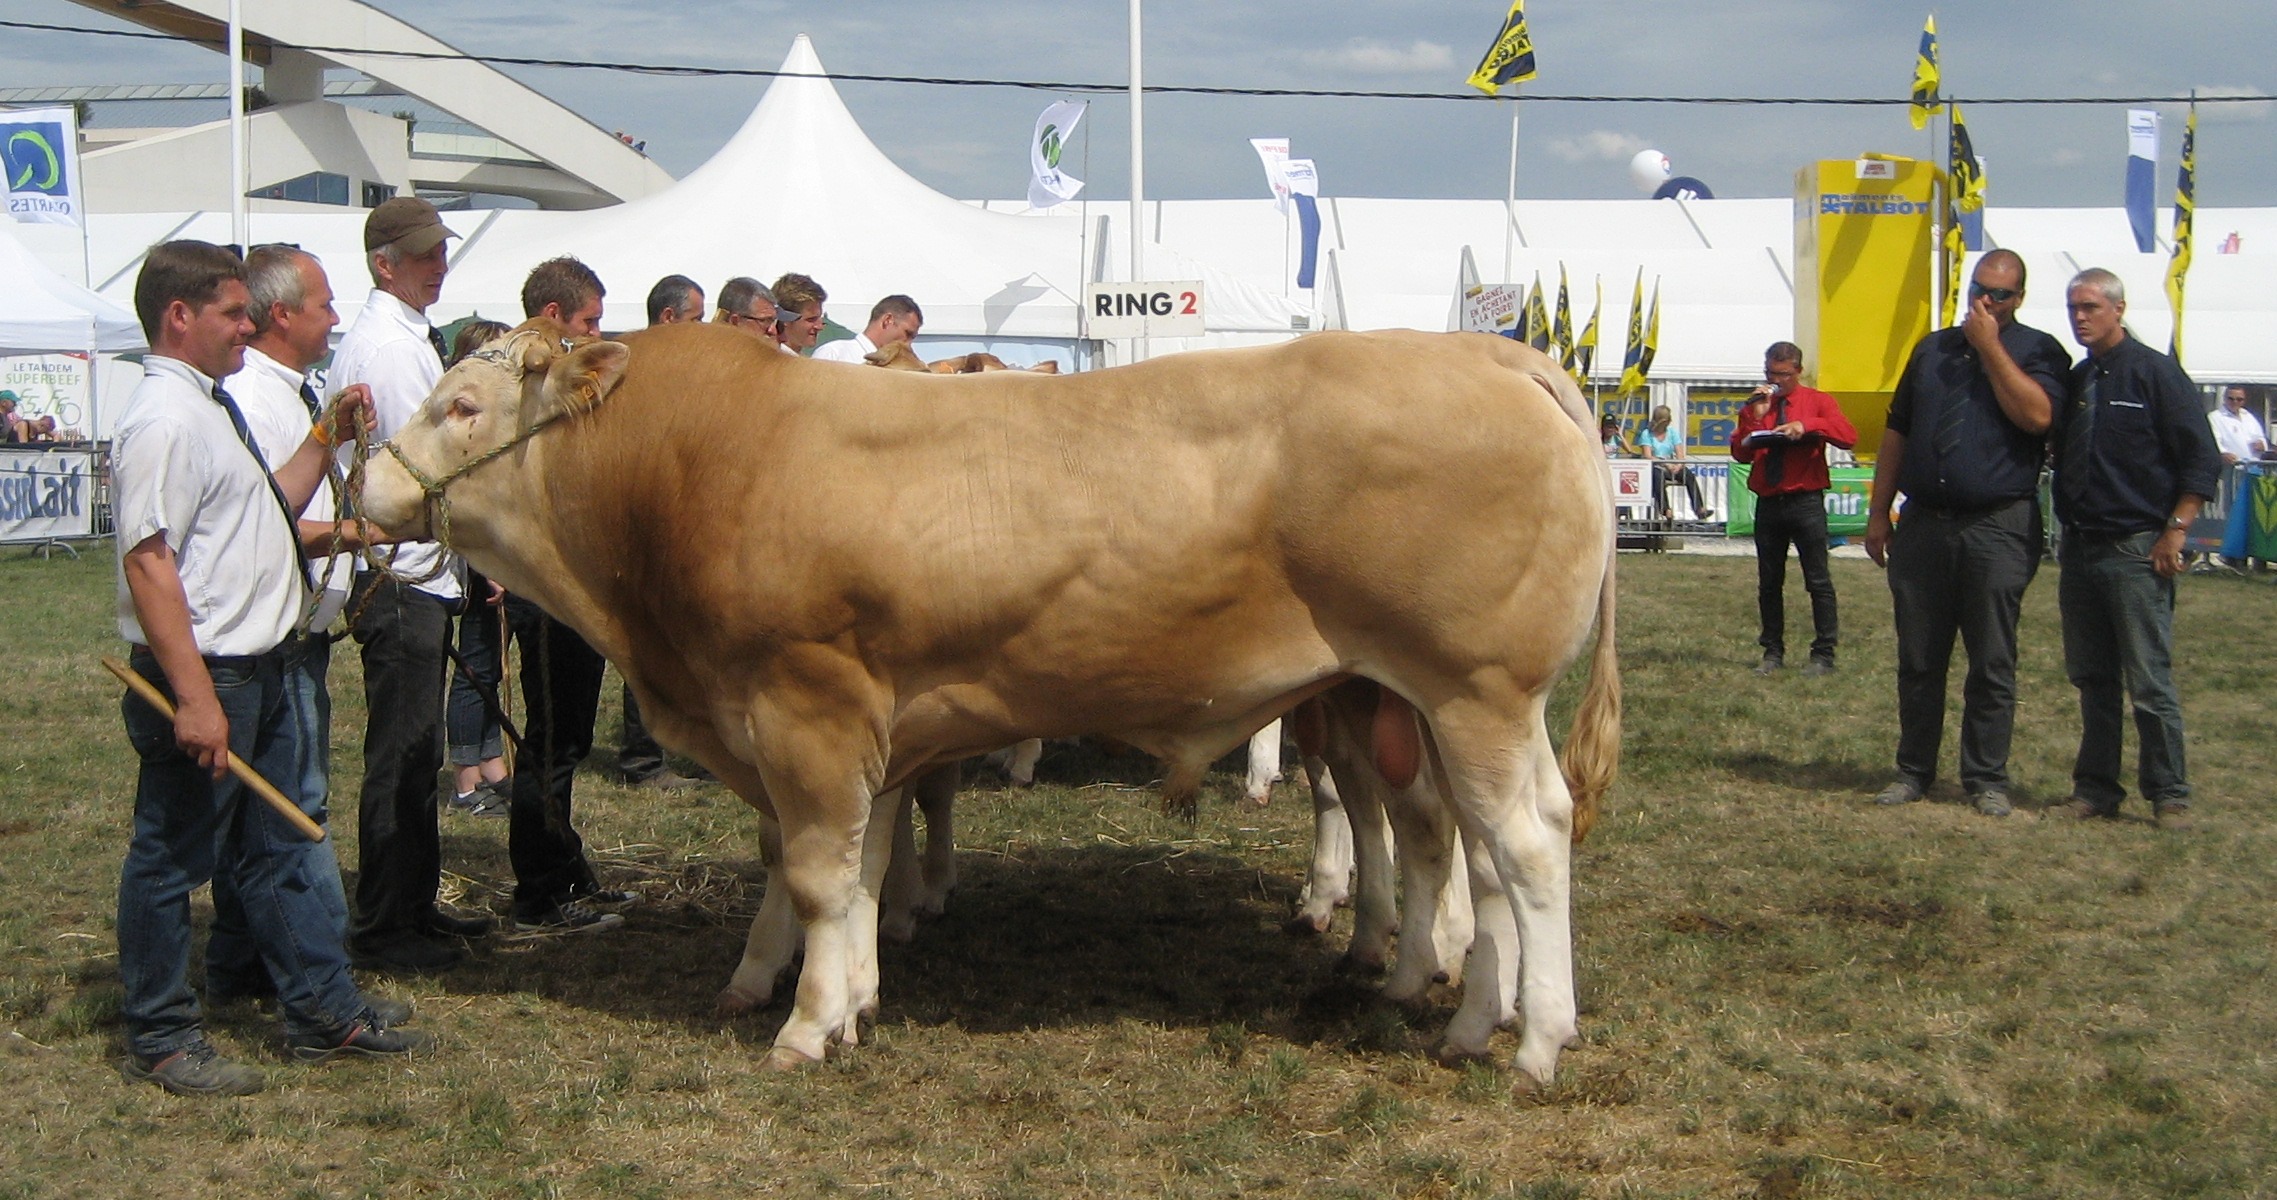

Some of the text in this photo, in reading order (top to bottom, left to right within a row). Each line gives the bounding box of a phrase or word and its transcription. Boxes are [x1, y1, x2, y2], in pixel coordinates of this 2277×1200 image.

[1840, 202, 1929, 215] TALBOT
[1476, 286, 1504, 305] GAGNEZ
[1096, 291, 1197, 317] RING 2
[1470, 307, 1479, 318] EN
[1482, 290, 1516, 313] ACHETANT
[1479, 313, 1489, 323] LA
[13, 362, 73, 373] LE TANDEM
[5, 373, 82, 386] SUPERBEEF
[1823, 485, 1862, 515] nir
